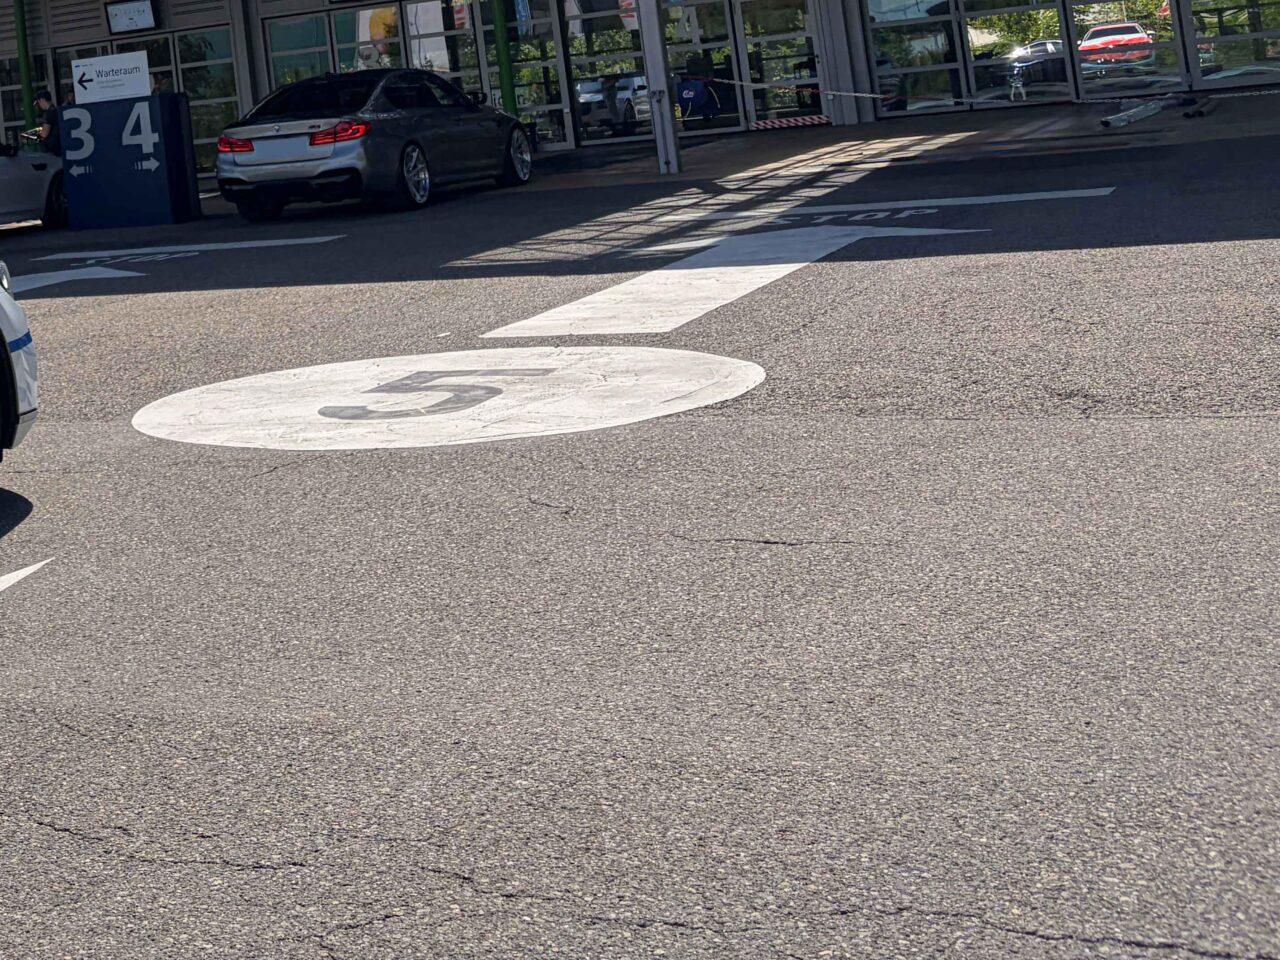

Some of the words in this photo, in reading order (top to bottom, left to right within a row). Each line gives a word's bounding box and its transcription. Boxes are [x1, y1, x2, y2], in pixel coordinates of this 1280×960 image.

[677, 6, 704, 45] 4
[95, 65, 141, 78] Warteraum
[62, 107, 95, 161] 3
[121, 101, 160, 154] 4
[763, 208, 938, 226] STOP
[317, 367, 554, 420] 5
